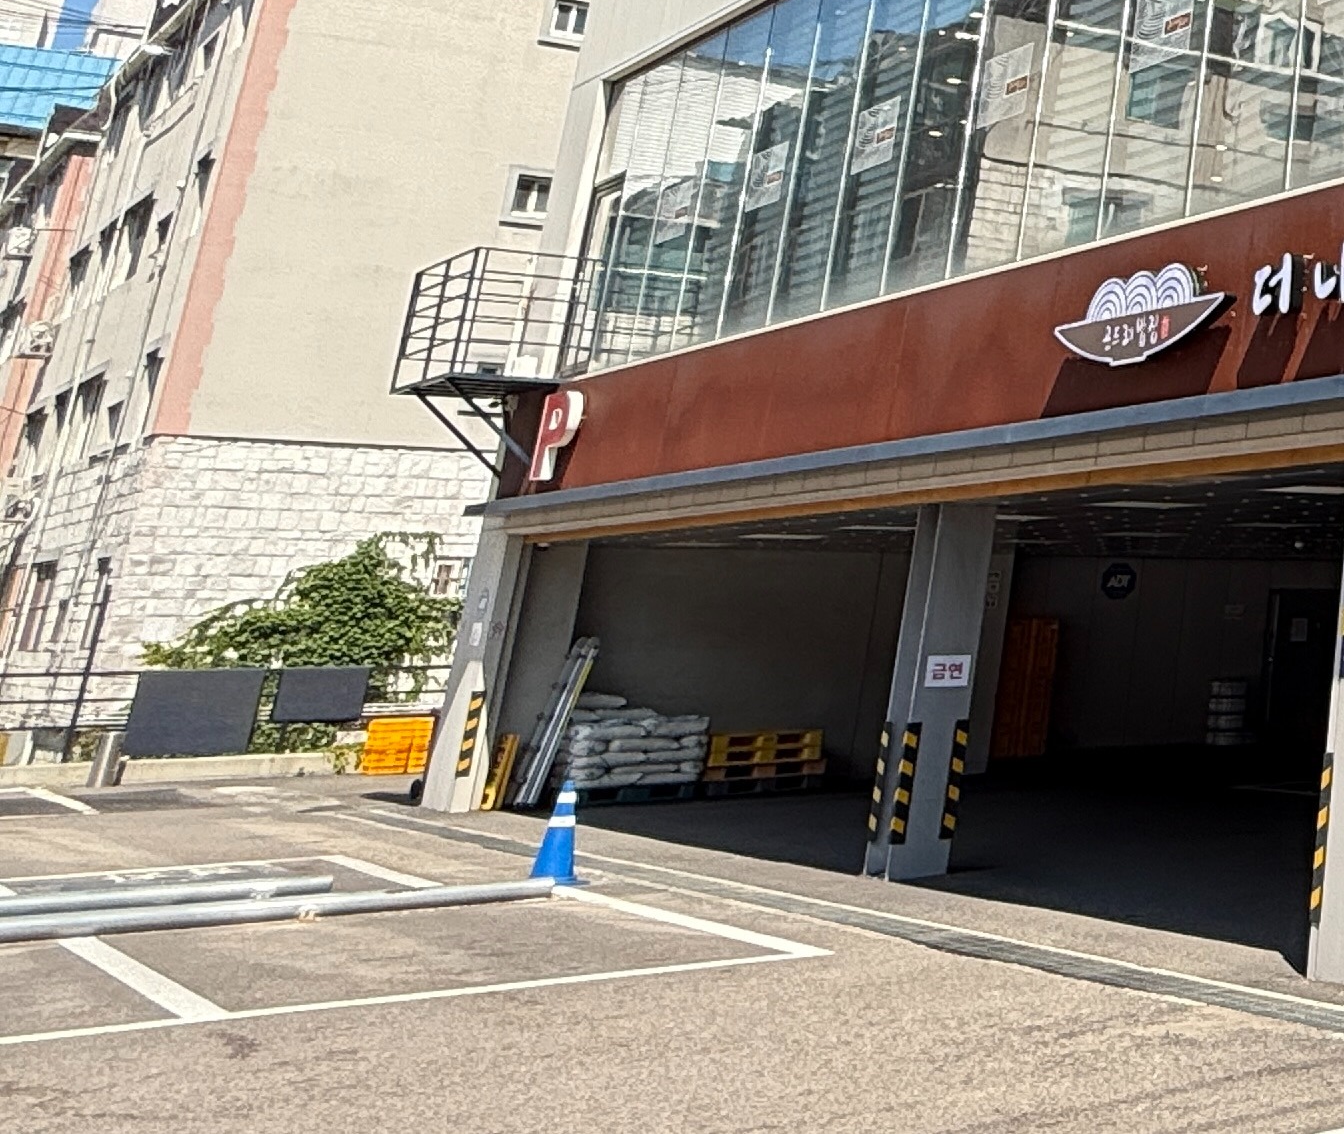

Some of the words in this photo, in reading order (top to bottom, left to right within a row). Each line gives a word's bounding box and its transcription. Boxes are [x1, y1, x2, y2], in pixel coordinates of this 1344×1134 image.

[1252, 253, 1293, 316] 더
[1102, 313, 1160, 352] 곤드레밥집
[529, 390, 584, 481] P
[931, 662, 965, 681] 금연
